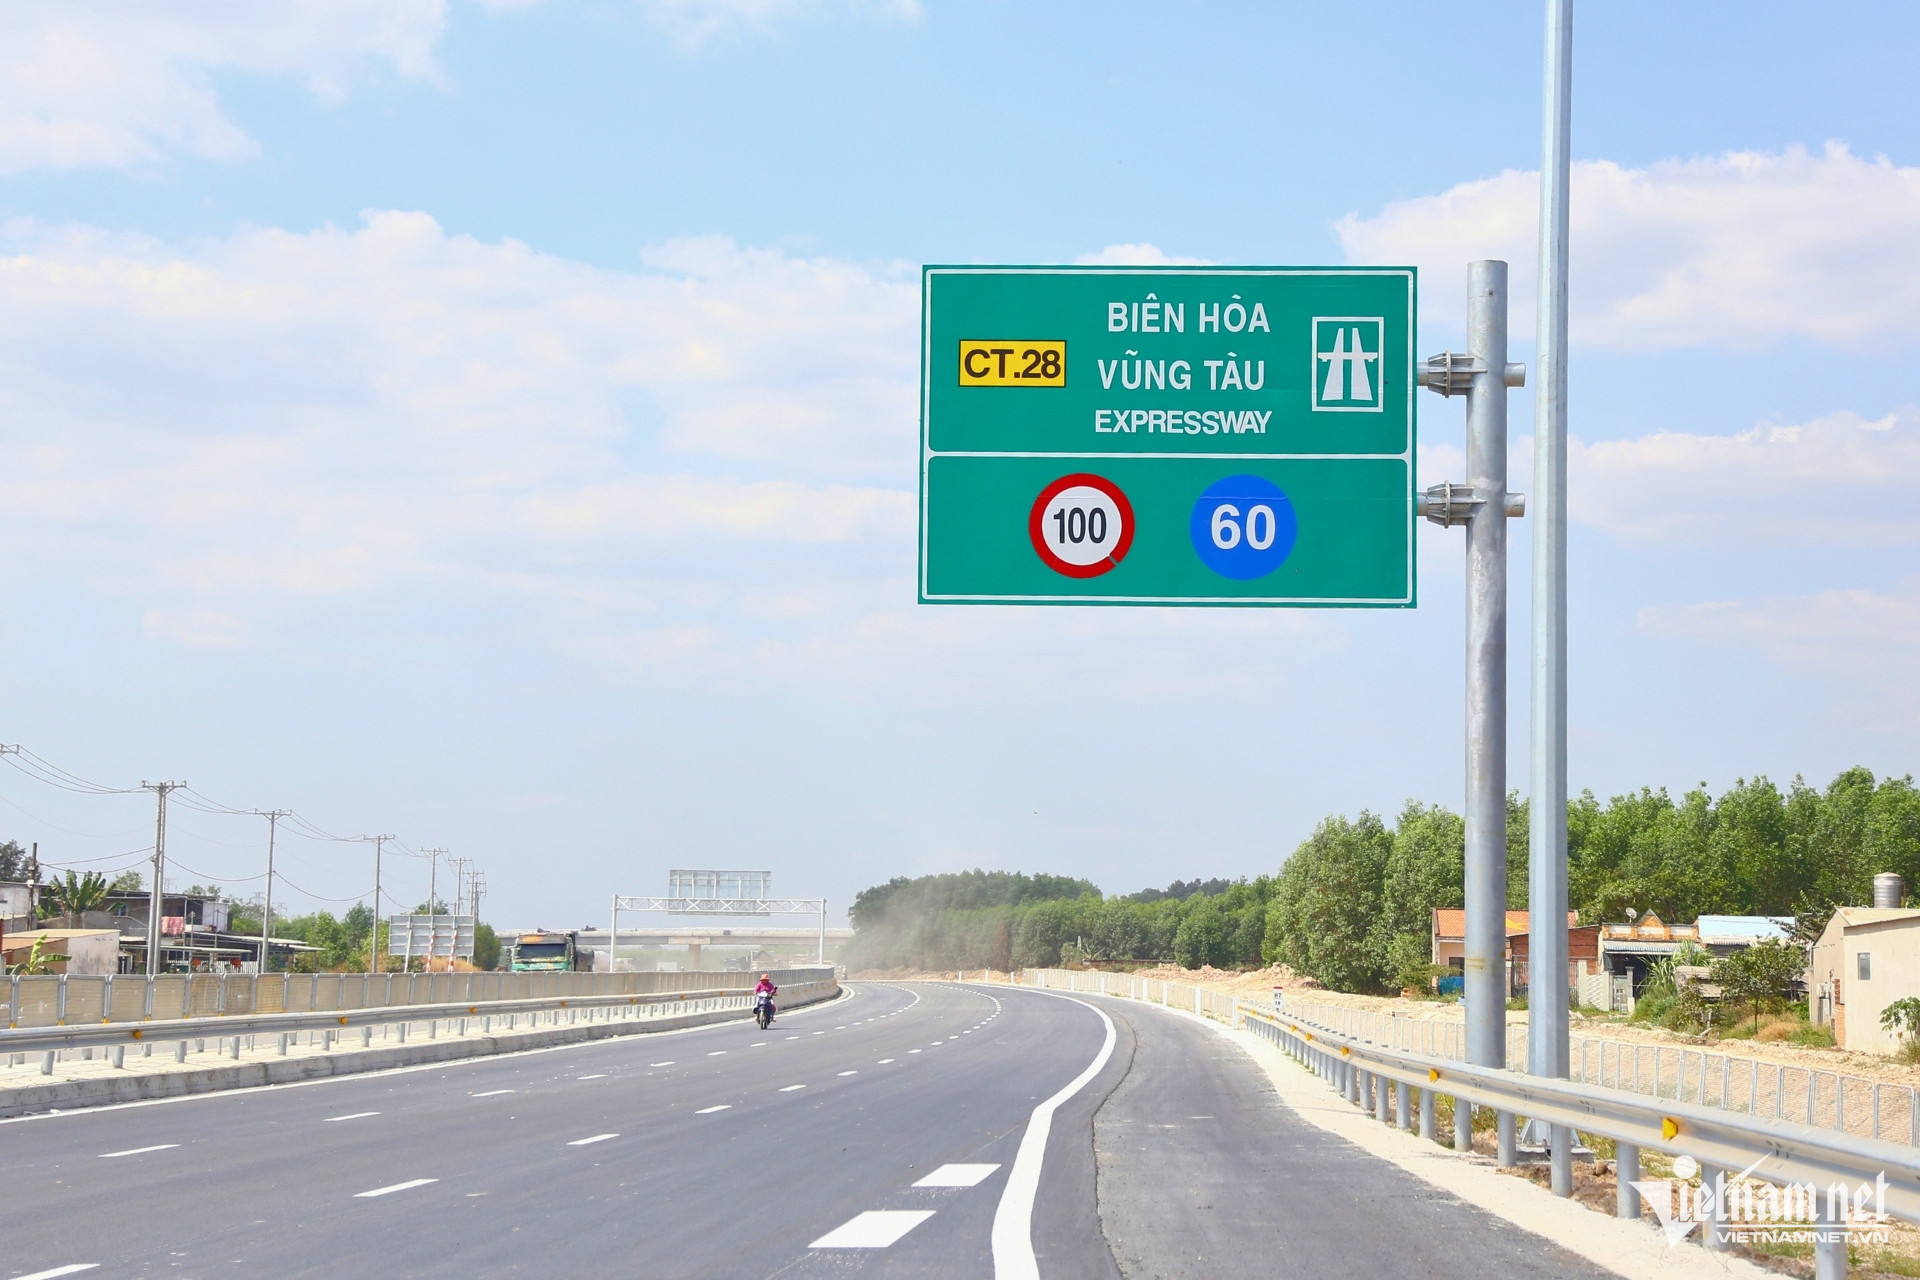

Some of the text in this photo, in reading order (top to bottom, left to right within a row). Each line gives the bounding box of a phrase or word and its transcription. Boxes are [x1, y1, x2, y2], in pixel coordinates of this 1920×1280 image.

[1107, 293, 1270, 333] BIÊN HÒA
[963, 348, 1062, 379] CT.28
[1098, 350, 1265, 390] VŨNG TÀU
[1094, 410, 1272, 434] EXPRESSWAY
[1053, 507, 1107, 544] 100
[1210, 504, 1276, 550] 60
